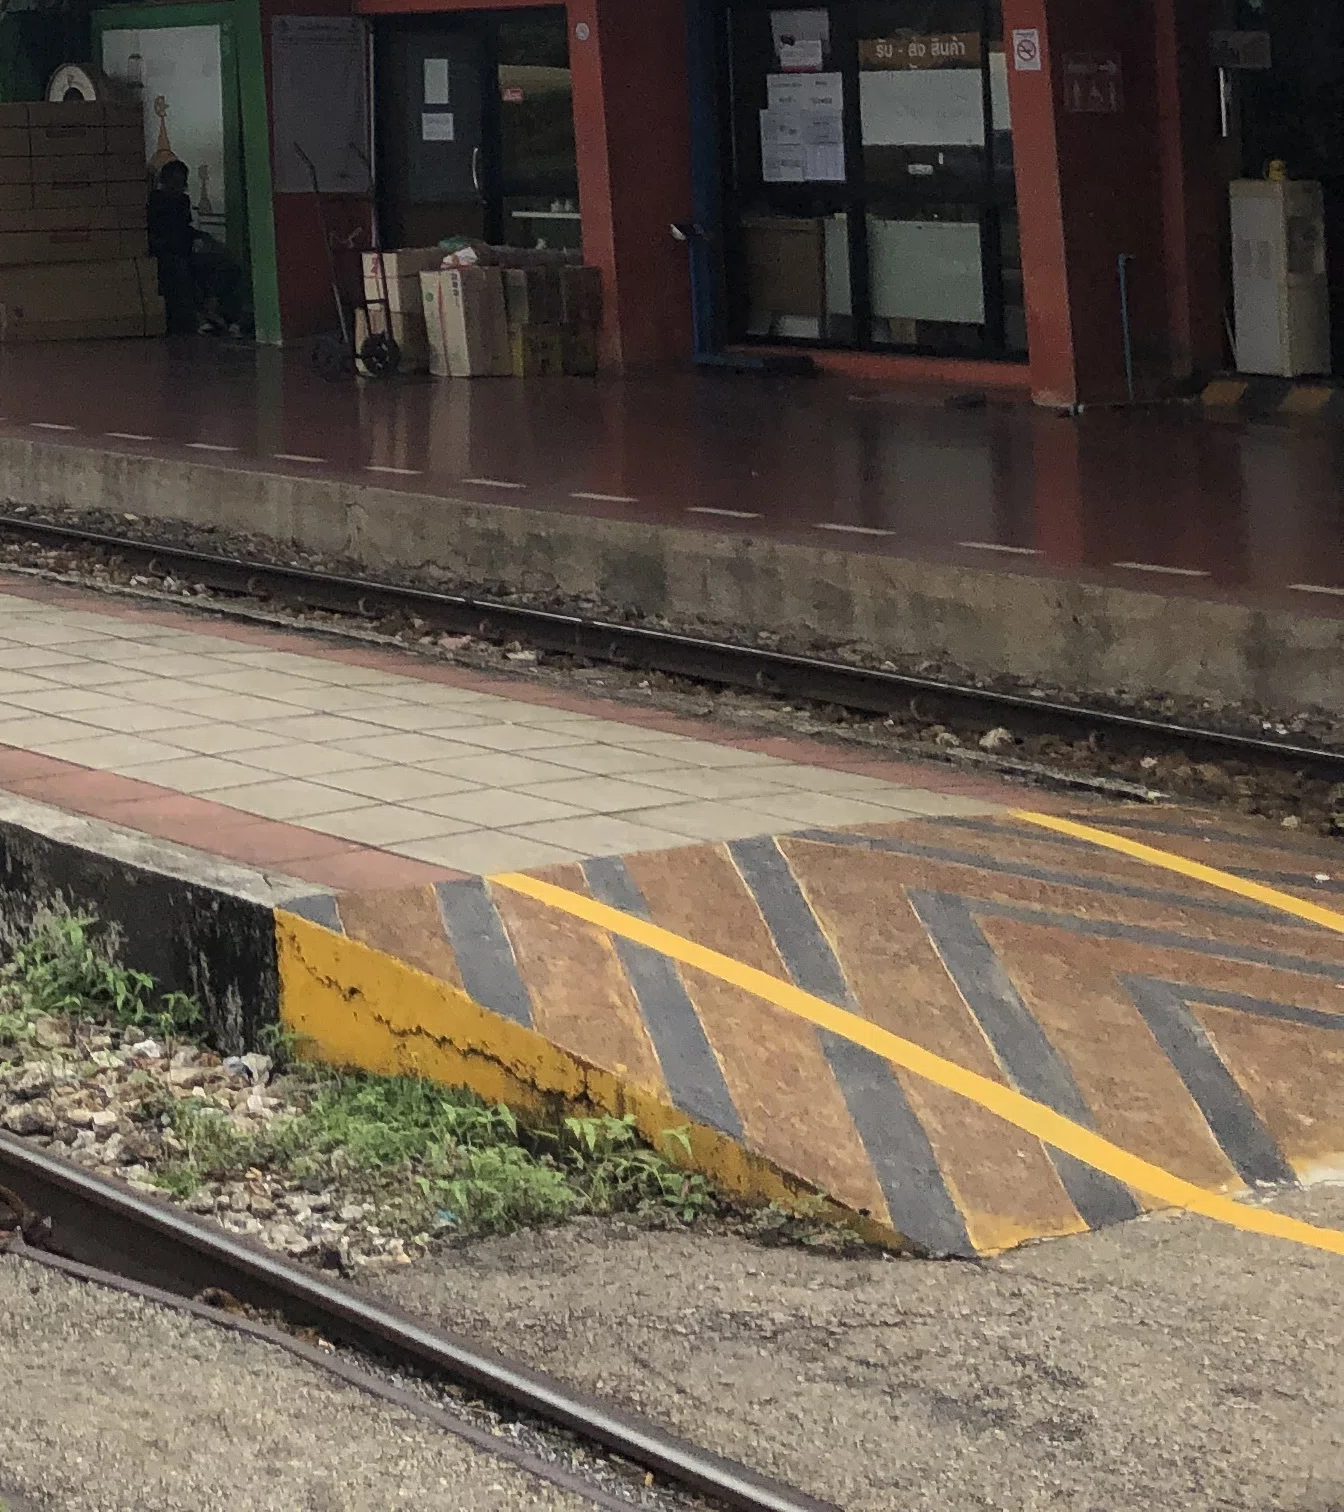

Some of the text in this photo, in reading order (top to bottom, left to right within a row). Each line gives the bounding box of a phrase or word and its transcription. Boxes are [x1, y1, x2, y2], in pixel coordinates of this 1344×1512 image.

[875, 38, 893, 58] รับ
[930, 35, 966, 56] สินค้า
